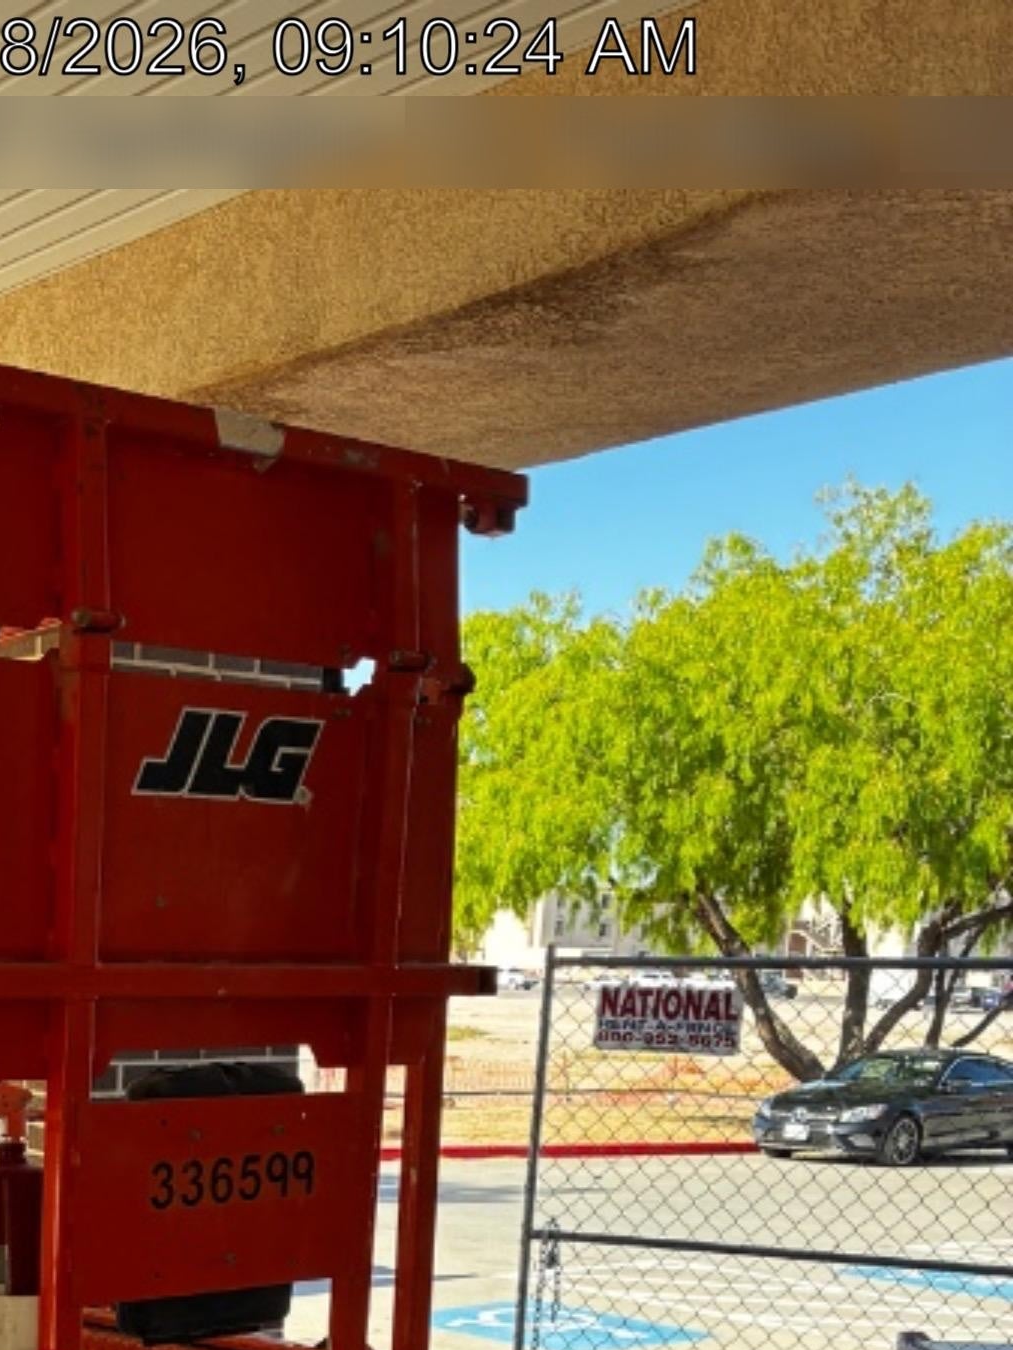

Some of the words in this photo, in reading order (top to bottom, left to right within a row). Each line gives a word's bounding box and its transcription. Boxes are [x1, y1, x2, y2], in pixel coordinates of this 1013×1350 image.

[131, 706, 326, 804] JLG
[598, 985, 739, 1022] NATIONAL
[150, 1150, 316, 1210] 336599
